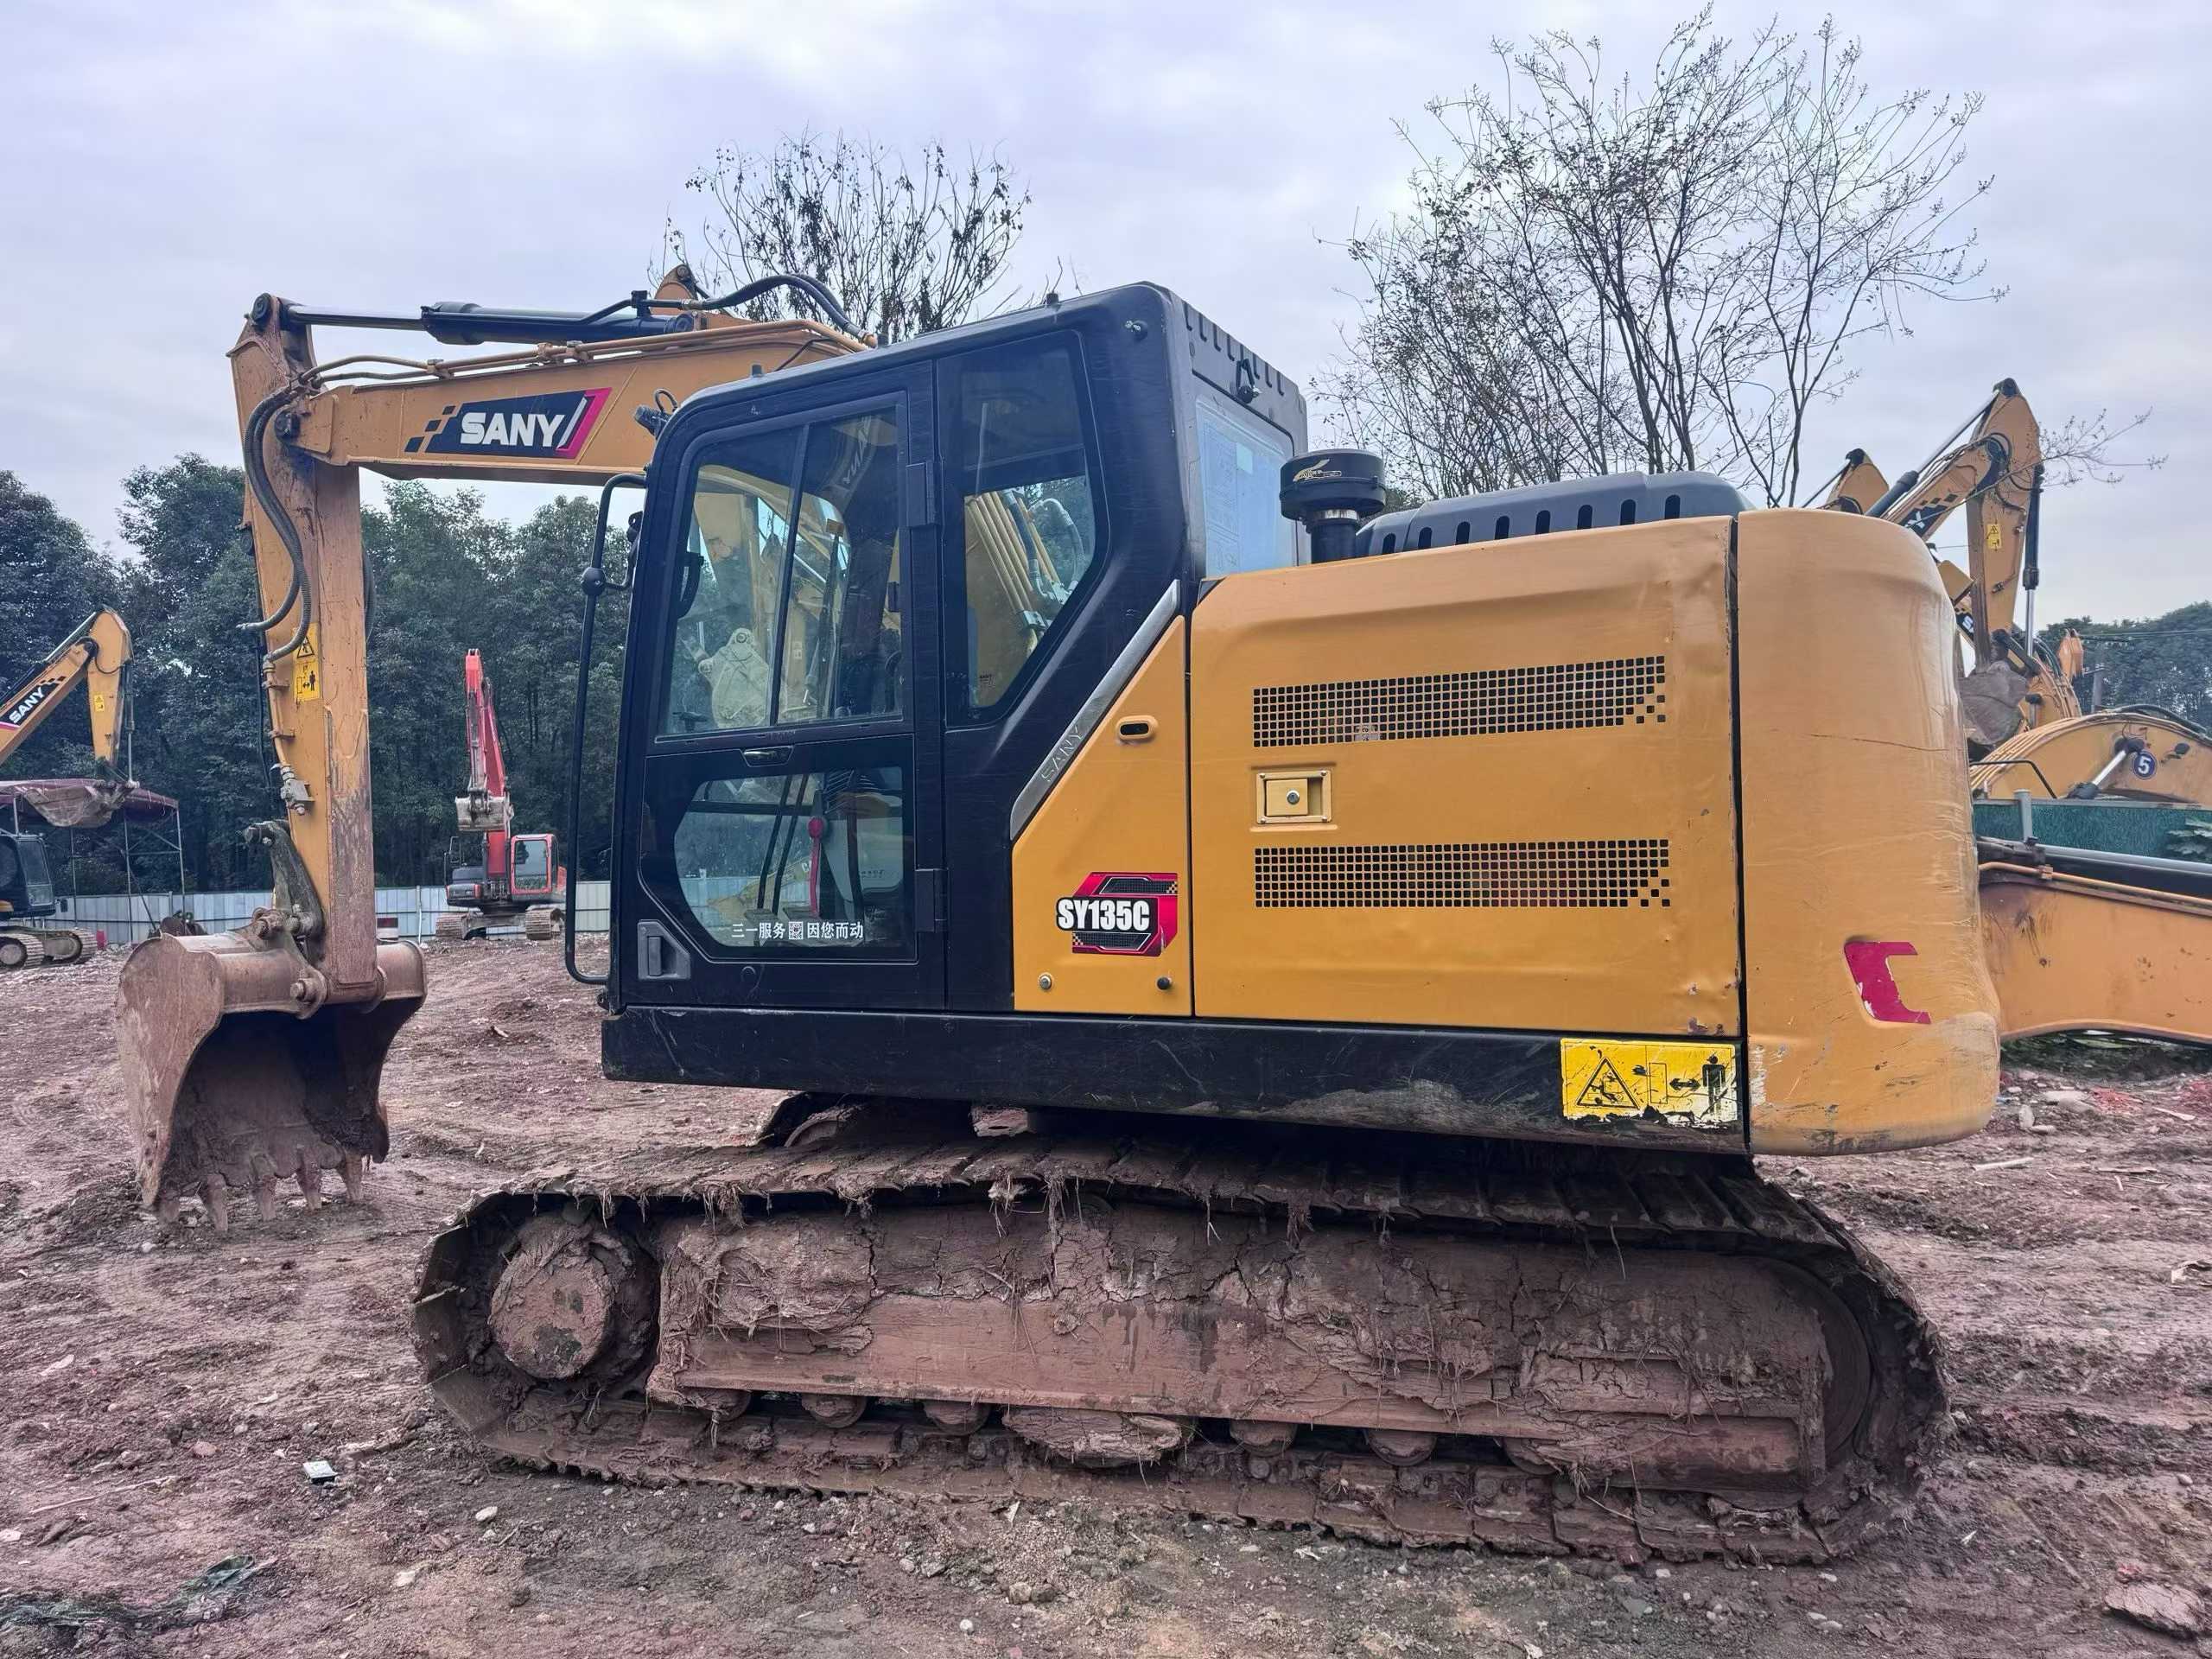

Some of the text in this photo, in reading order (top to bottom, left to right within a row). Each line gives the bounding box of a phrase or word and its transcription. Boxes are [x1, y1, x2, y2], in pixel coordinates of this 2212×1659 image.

[460, 411, 565, 448] SANY
[8, 686, 45, 724] SANY
[1040, 724, 1084, 783] SANY
[2137, 754, 2153, 775] 5
[731, 921, 864, 940] 三一服务 因您而动
[1057, 898, 1151, 931] SY135C
